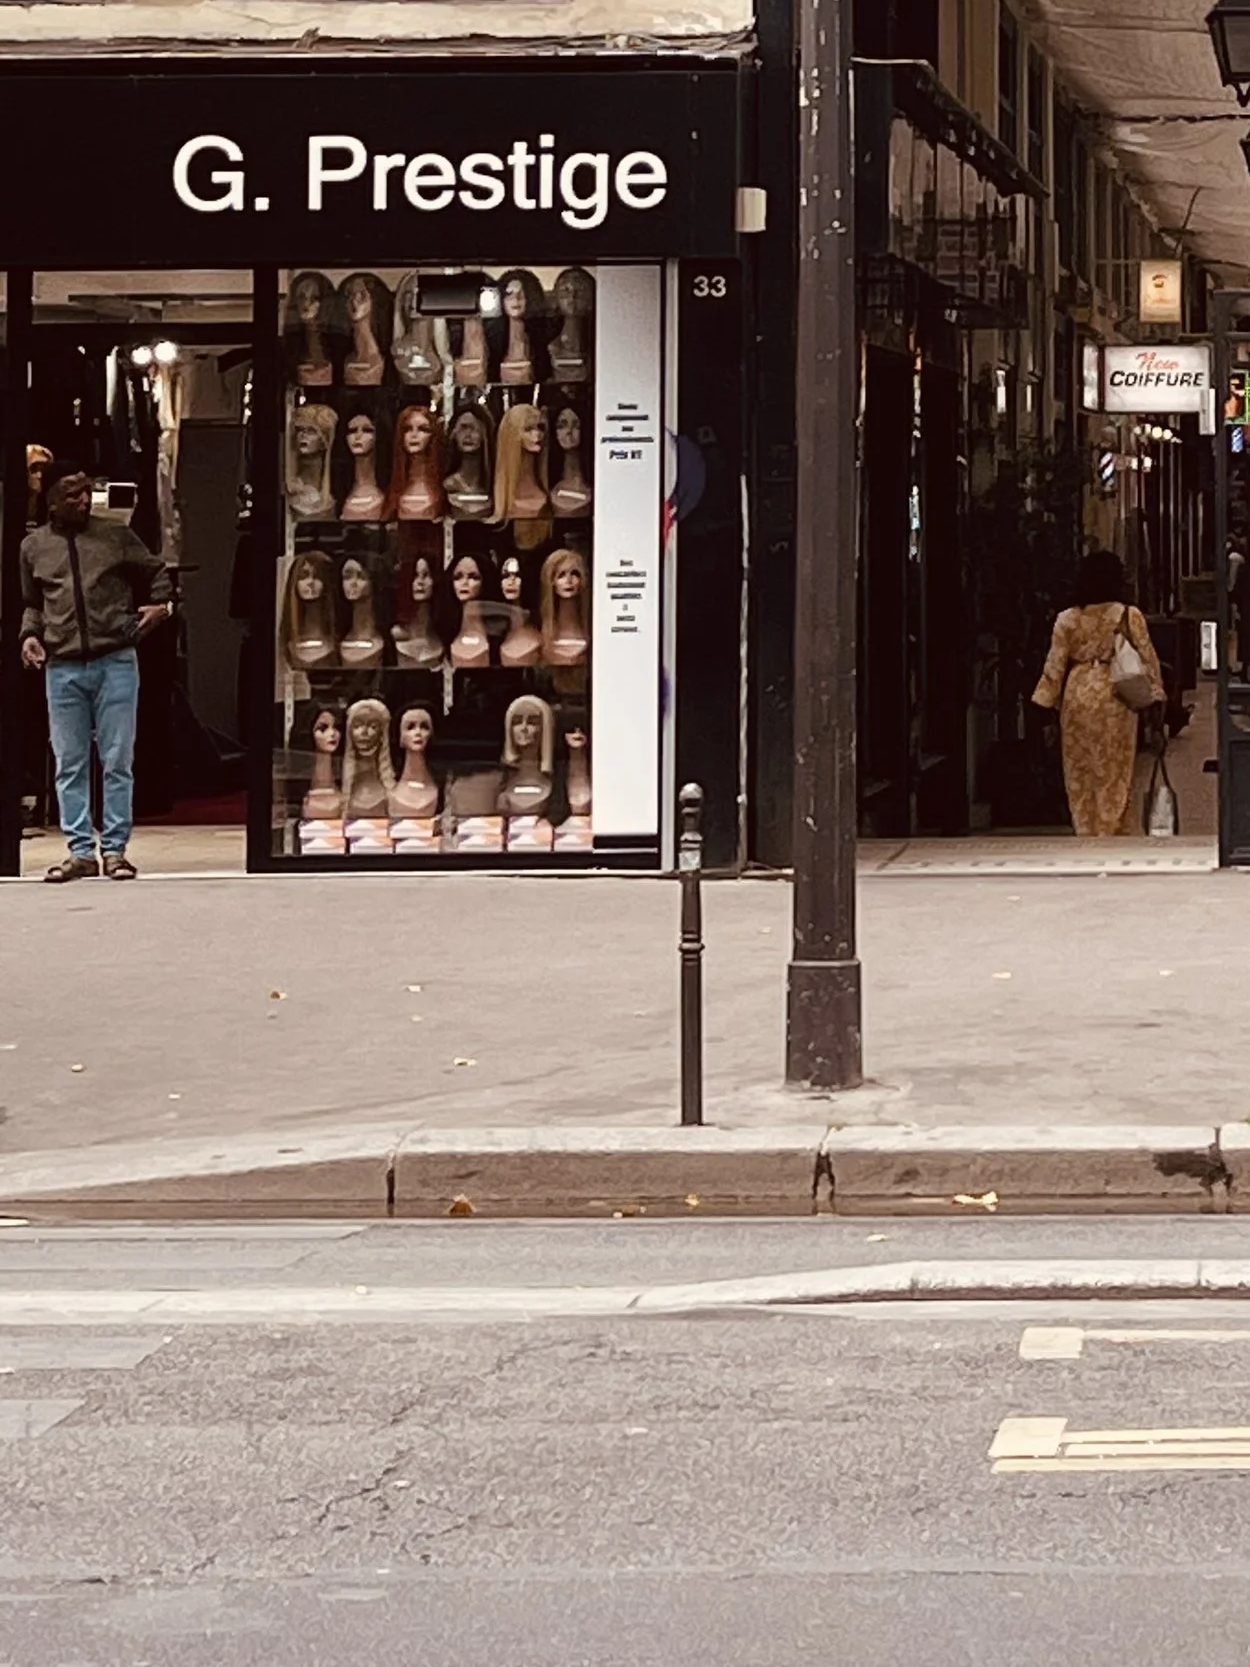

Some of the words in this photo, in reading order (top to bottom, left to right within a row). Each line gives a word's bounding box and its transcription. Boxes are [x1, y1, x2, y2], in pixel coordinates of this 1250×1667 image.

[172, 135, 270, 211] G.
[307, 134, 668, 229] Prestige
[693, 275, 727, 298] 33
[1135, 350, 1180, 371] New
[1109, 370, 1205, 387] COIFFURE
